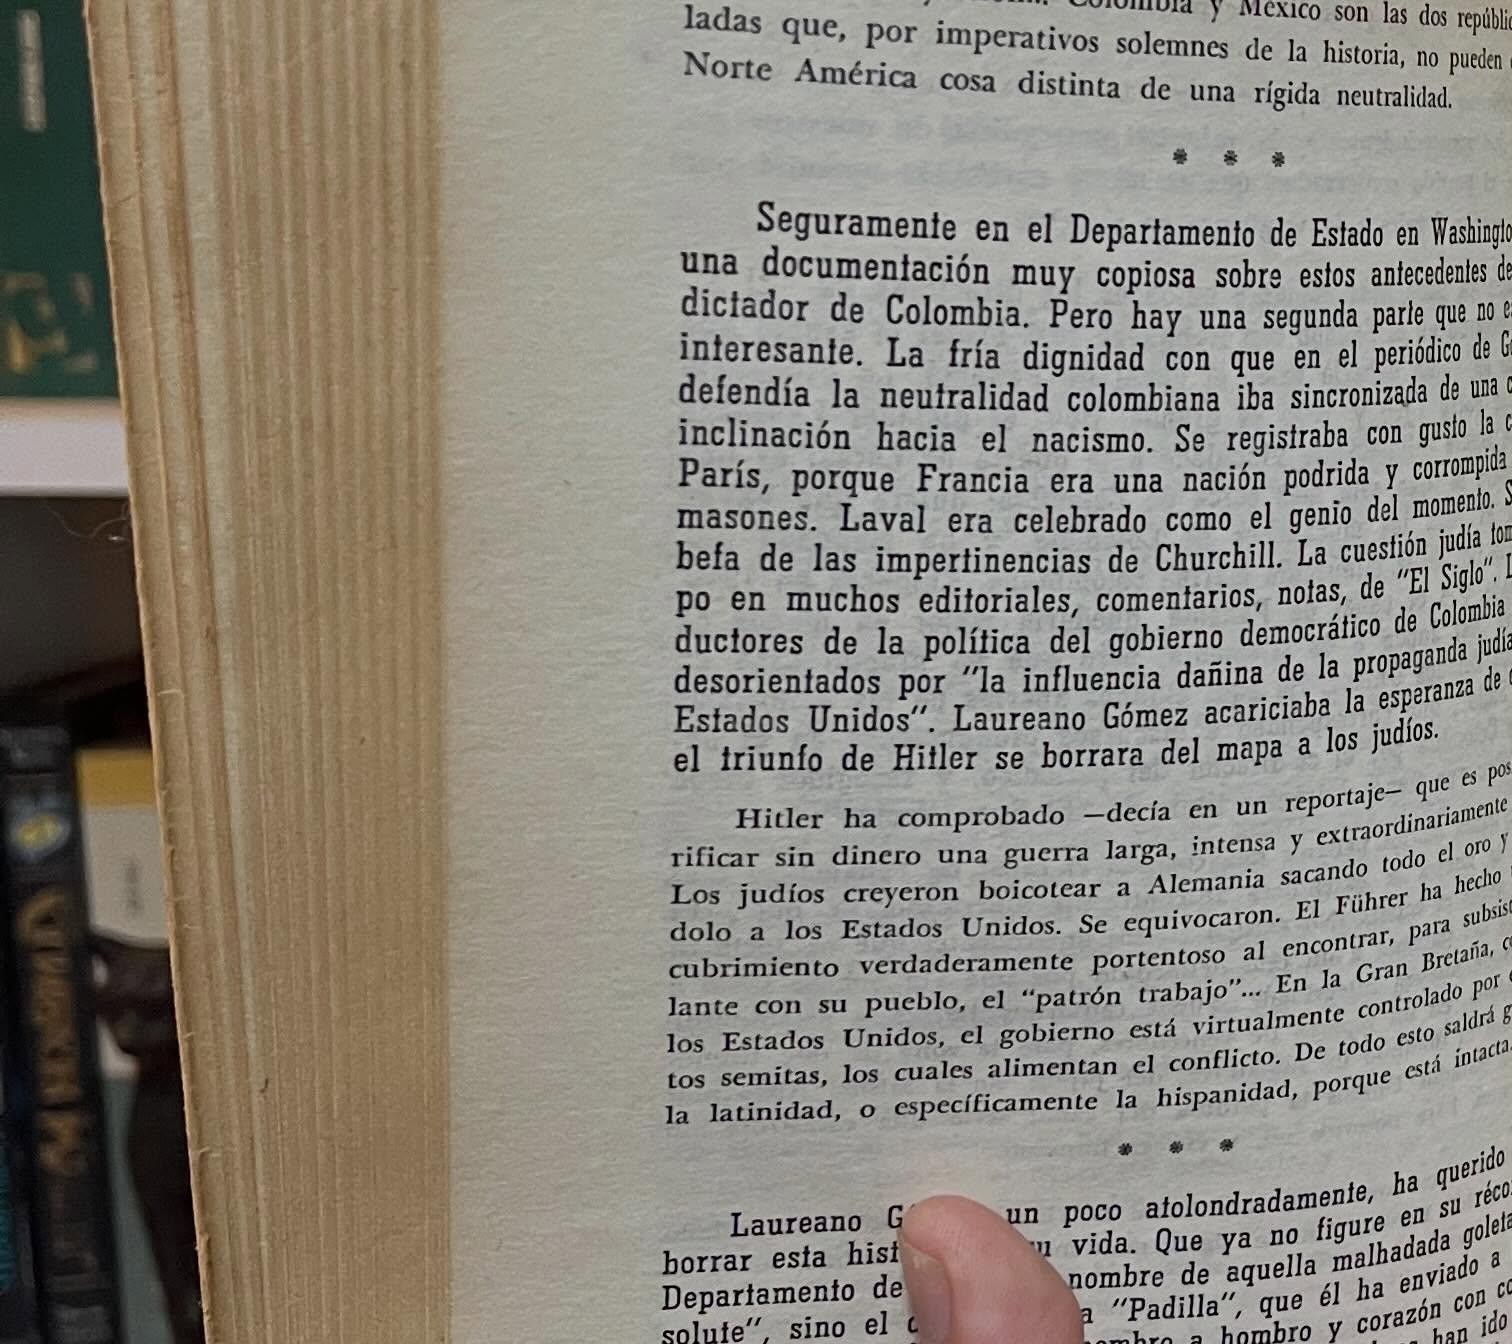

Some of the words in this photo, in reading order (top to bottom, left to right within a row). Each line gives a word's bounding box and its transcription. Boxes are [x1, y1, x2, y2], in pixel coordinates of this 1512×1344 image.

[1334, 4, 1369, 23] son
[1382, 0, 1408, 25] las
[1418, 2, 1448, 27] dos
[681, 287, 808, 320] dictador
[830, 290, 865, 325] de
[886, 292, 1030, 329] Colombia.
[1048, 297, 1113, 330] Pero
[1130, 299, 1183, 338] hay
[1199, 309, 1247, 331] una
[1263, 298, 1359, 337] segunda
[1372, 299, 1424, 335] parte
[1435, 303, 1467, 332] que
[1476, 301, 1495, 322] no
[673, 704, 790, 734] Estados
[952, 703, 1086, 732] Laureano
[1103, 701, 1189, 730] Gómez
[1204, 690, 1331, 725] acariciaba
[1344, 687, 1365, 715] la
[1378, 677, 1475, 714] esperanza
[1483, 664, 1501, 693] de
[735, 807, 825, 830] Hitler
[843, 807, 878, 829] ha
[897, 803, 1065, 834] comprobado
[1188, 803, 1218, 819] en
[1236, 800, 1268, 817] un
[1415, 776, 1450, 803] que
[1461, 770, 1477, 787] es
[1071, 1229, 1137, 1257] vida.
[1155, 1227, 1203, 1257] Que
[1220, 1231, 1253, 1256] ya
[1268, 1227, 1299, 1247] no
[1316, 1215, 1385, 1244] figure
[1400, 1207, 1425, 1228] en
[1439, 1196, 1461, 1219] su
[661, 1249, 753, 1276] borrar
[771, 1244, 828, 1270] esta
